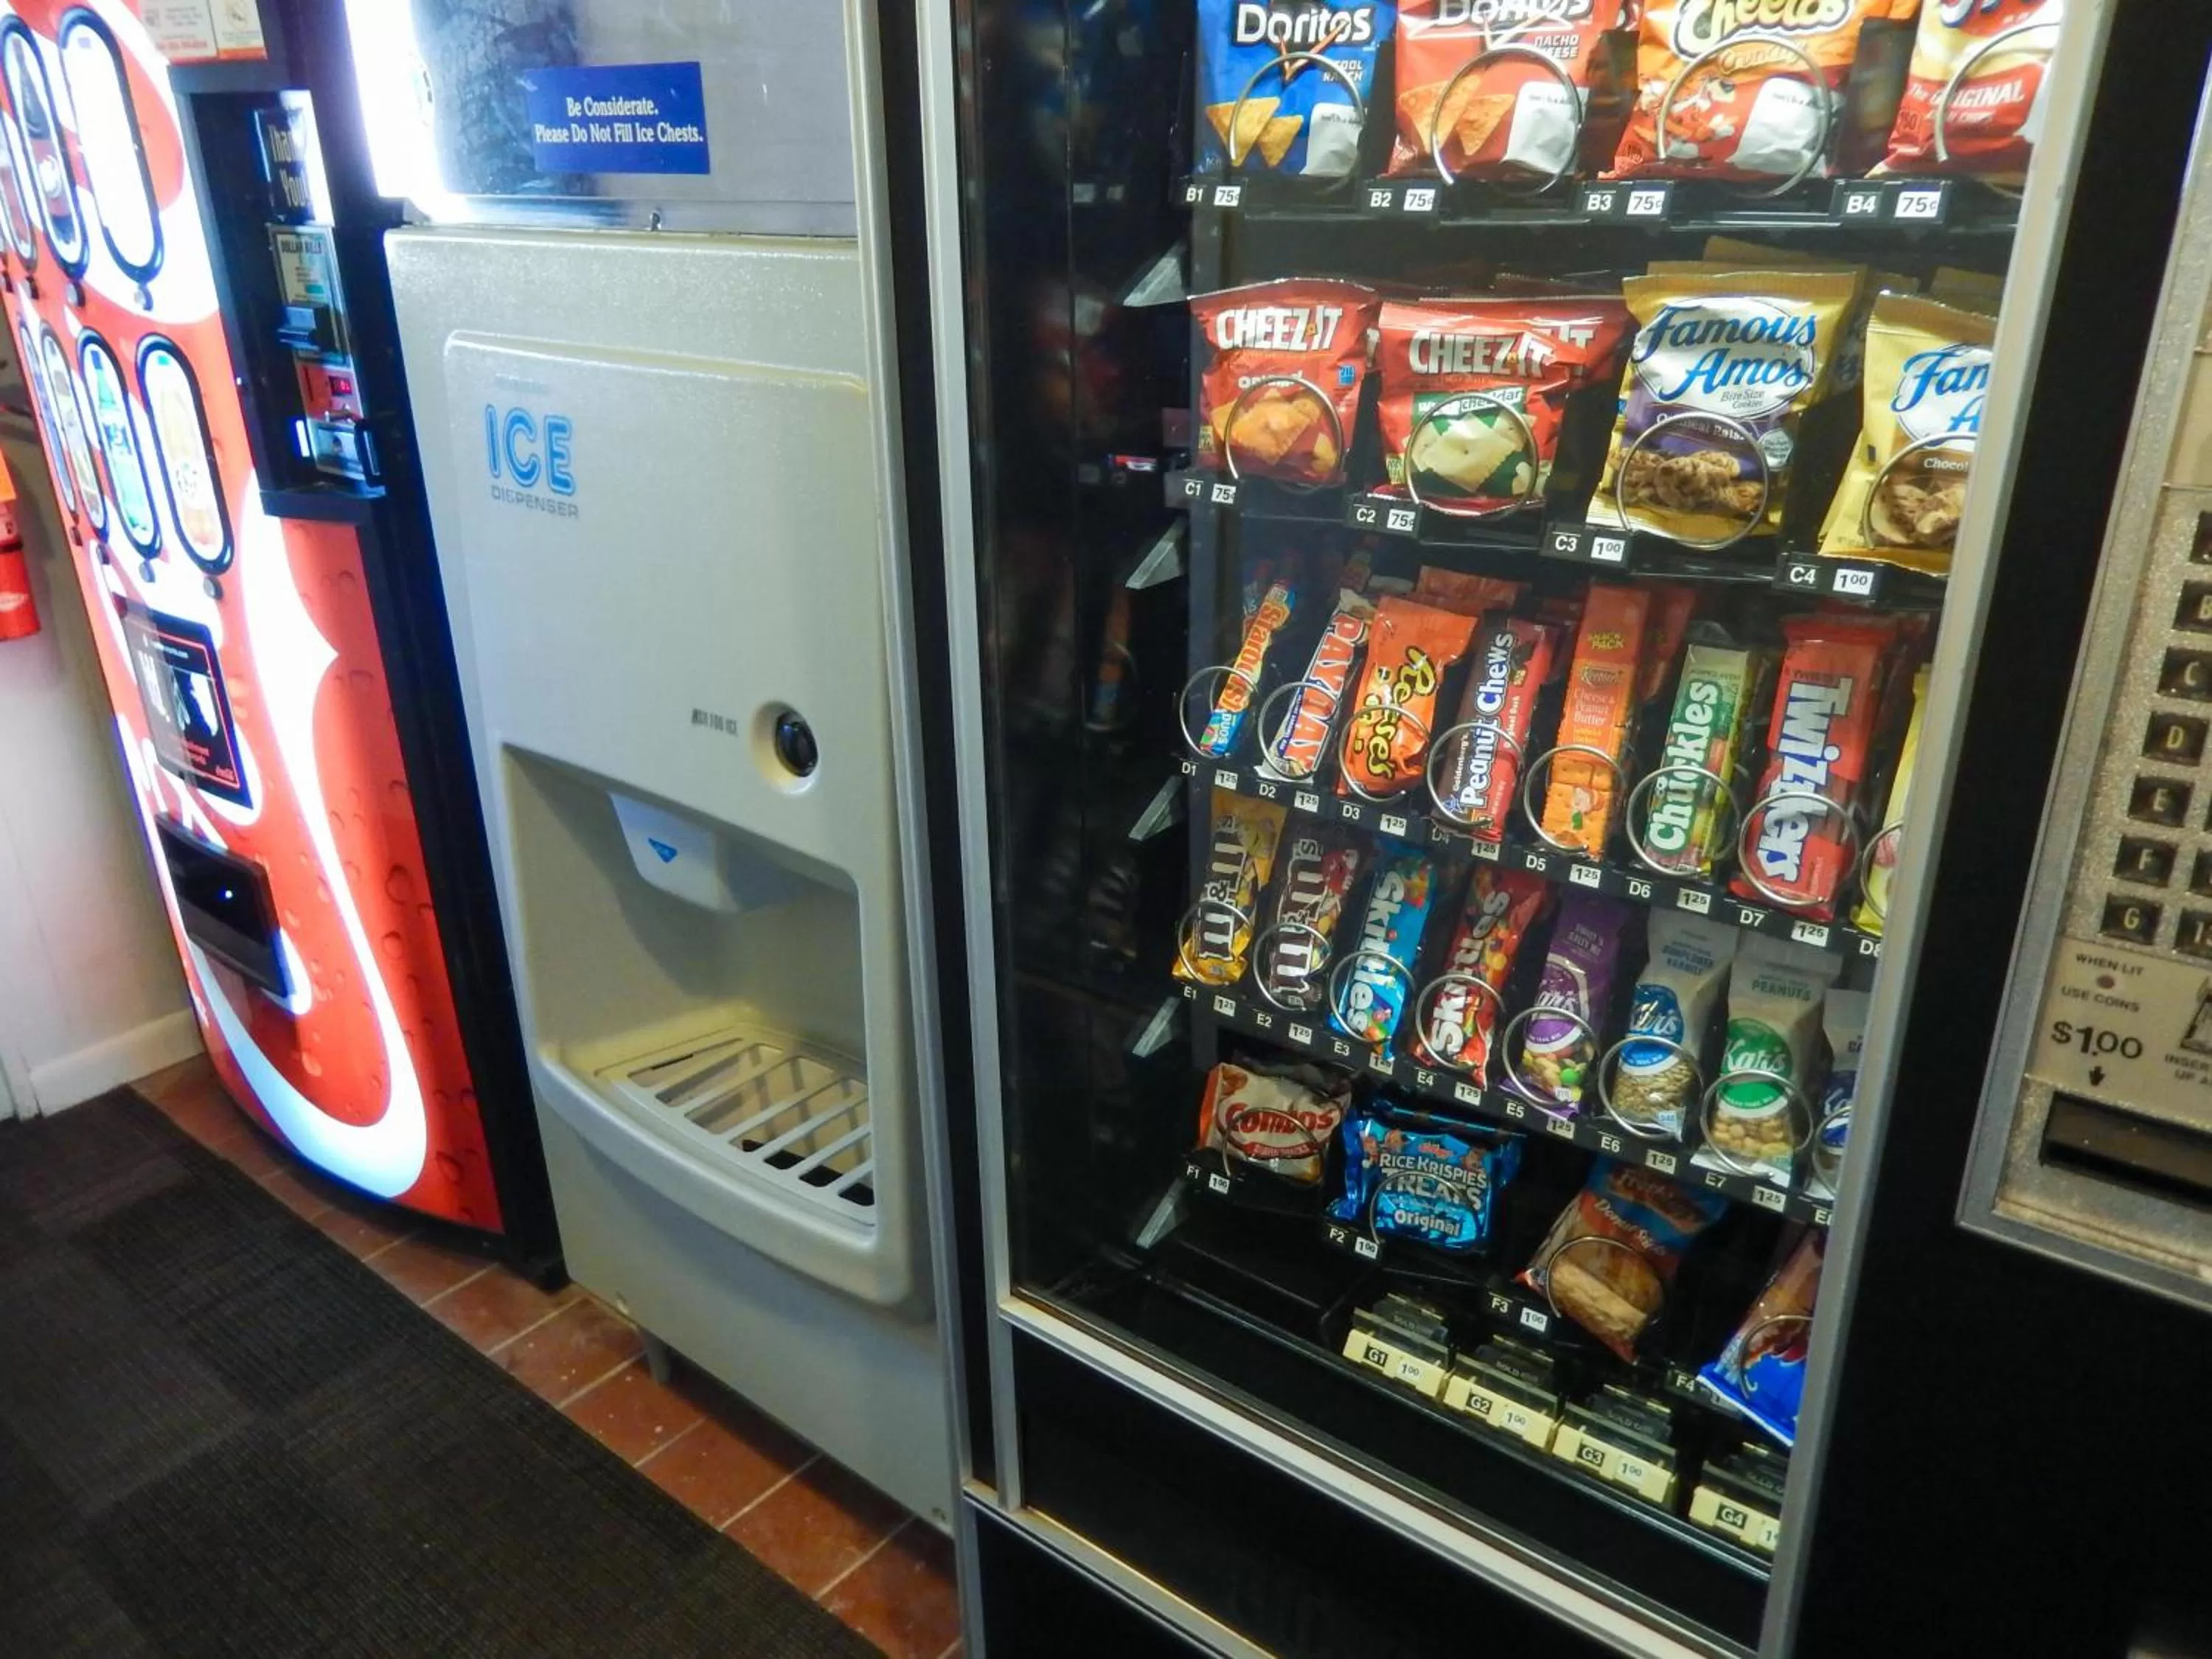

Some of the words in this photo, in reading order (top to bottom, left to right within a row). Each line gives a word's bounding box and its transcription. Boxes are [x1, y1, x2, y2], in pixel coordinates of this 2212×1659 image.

[1236, 4, 1372, 44] Doritos
[1534, 35, 1579, 46] NACHO
[1930, 80, 2026, 108] OIGINAL
[566, 97, 581, 116] Be
[583, 96, 658, 116] Considerate.
[534, 124, 569, 142] Please
[571, 123, 588, 142] Do
[589, 123, 612, 142] Not
[613, 123, 633, 142] Fill
[636, 122, 654, 142] Ice
[657, 122, 704, 142] Chests.
[1186, 187, 1203, 202] B1
[1370, 192, 1392, 207] B2
[1587, 195, 1613, 211] B3
[1846, 195, 1877, 213] B4
[1631, 305, 1817, 363] Famous
[1659, 348, 1812, 401] Amos
[1891, 350, 1990, 412] Fam
[485, 403, 577, 496] ICE
[1185, 483, 1202, 496] C1
[492, 484, 579, 520] DISPENSER
[1355, 508, 1376, 523] C2
[1554, 535, 1577, 553] C3
[1789, 566, 1817, 585] C4
[1475, 630, 1514, 717] Chews
[2184, 661, 2200, 686] C
[1283, 613, 1364, 772] PAYDAY
[2165, 725, 2184, 750] D
[1182, 762, 1197, 776] D1
[1459, 717, 1500, 807] Peanut
[1648, 680, 1719, 851] Chuckles
[1259, 784, 1277, 798] D2
[2153, 787, 2168, 812] E
[1342, 805, 1360, 819] D3
[1526, 854, 1546, 871] D5
[2139, 849, 2154, 871] F
[1628, 881, 1652, 899] D6
[1739, 909, 1765, 927] D7
[2124, 908, 2140, 930] G
[2076, 953, 2118, 972] WHEN
[2121, 964, 2144, 976] LIT
[1183, 987, 1197, 1000] E1
[1751, 980, 1812, 1001] PEANUTS
[2061, 985, 2089, 1002] USE
[2093, 992, 2141, 1013] COINS
[1256, 1013, 1273, 1029] E2
[1333, 1040, 1350, 1057] E3
[2051, 1020, 2143, 1059] $1.00
[1417, 1071, 1435, 1086] E4
[1506, 1102, 1525, 1119] E5
[1600, 1135, 1621, 1152] E6
[1186, 1166, 1200, 1178] F1
[1380, 1153, 1415, 1168] RICE
[1416, 1155, 1487, 1189] KRISPIES
[1381, 1167, 1483, 1211] TREATS
[1705, 1172, 1727, 1189] E7
[1394, 1208, 1461, 1237] Original
[1329, 1228, 1346, 1244] F2
[1491, 1296, 1509, 1314] F3
[1368, 1348, 1387, 1365] G1
[1675, 1375, 1696, 1393] F4
[1470, 1396, 1492, 1413] G2
[1581, 1447, 1604, 1465] G3
[1720, 1509, 1743, 1527] G4
